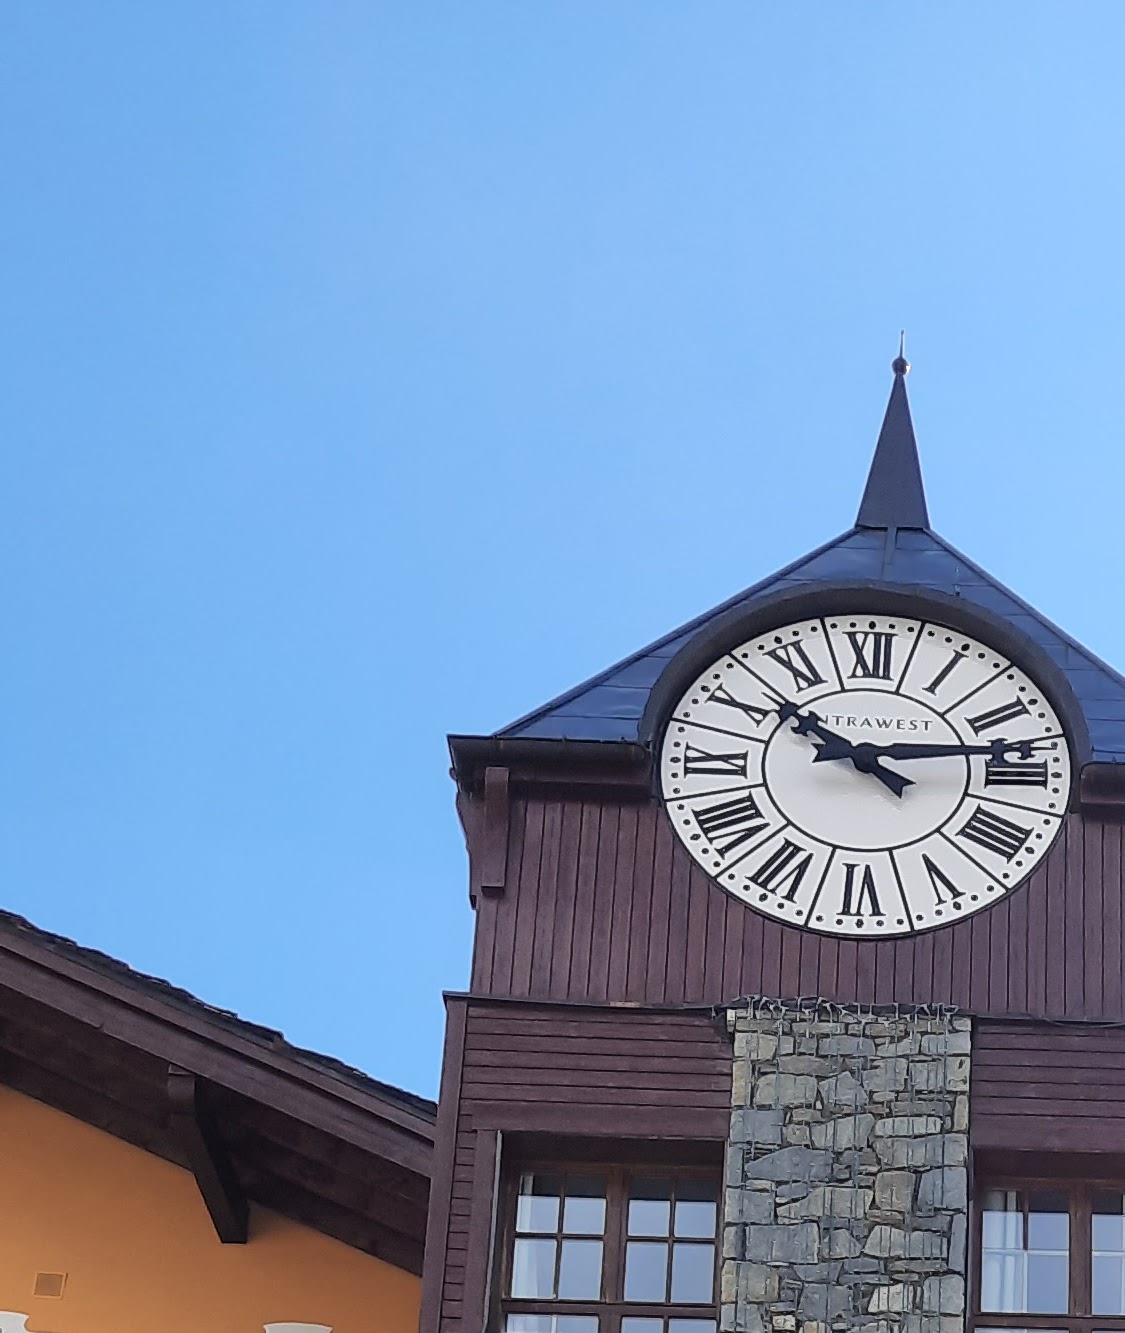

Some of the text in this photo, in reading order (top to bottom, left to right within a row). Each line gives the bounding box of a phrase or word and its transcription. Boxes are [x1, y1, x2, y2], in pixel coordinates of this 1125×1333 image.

[766, 639, 828, 693] XI
[843, 631, 898, 680] XII
[923, 650, 969, 694] I
[704, 682, 780, 728] X
[964, 695, 1032, 735] II
[683, 741, 749, 779] IX
[691, 790, 771, 860] VIII
[957, 804, 1034, 862] IIII
[746, 838, 814, 903] VII
[837, 862, 886, 917] VI
[922, 853, 966, 905] V
